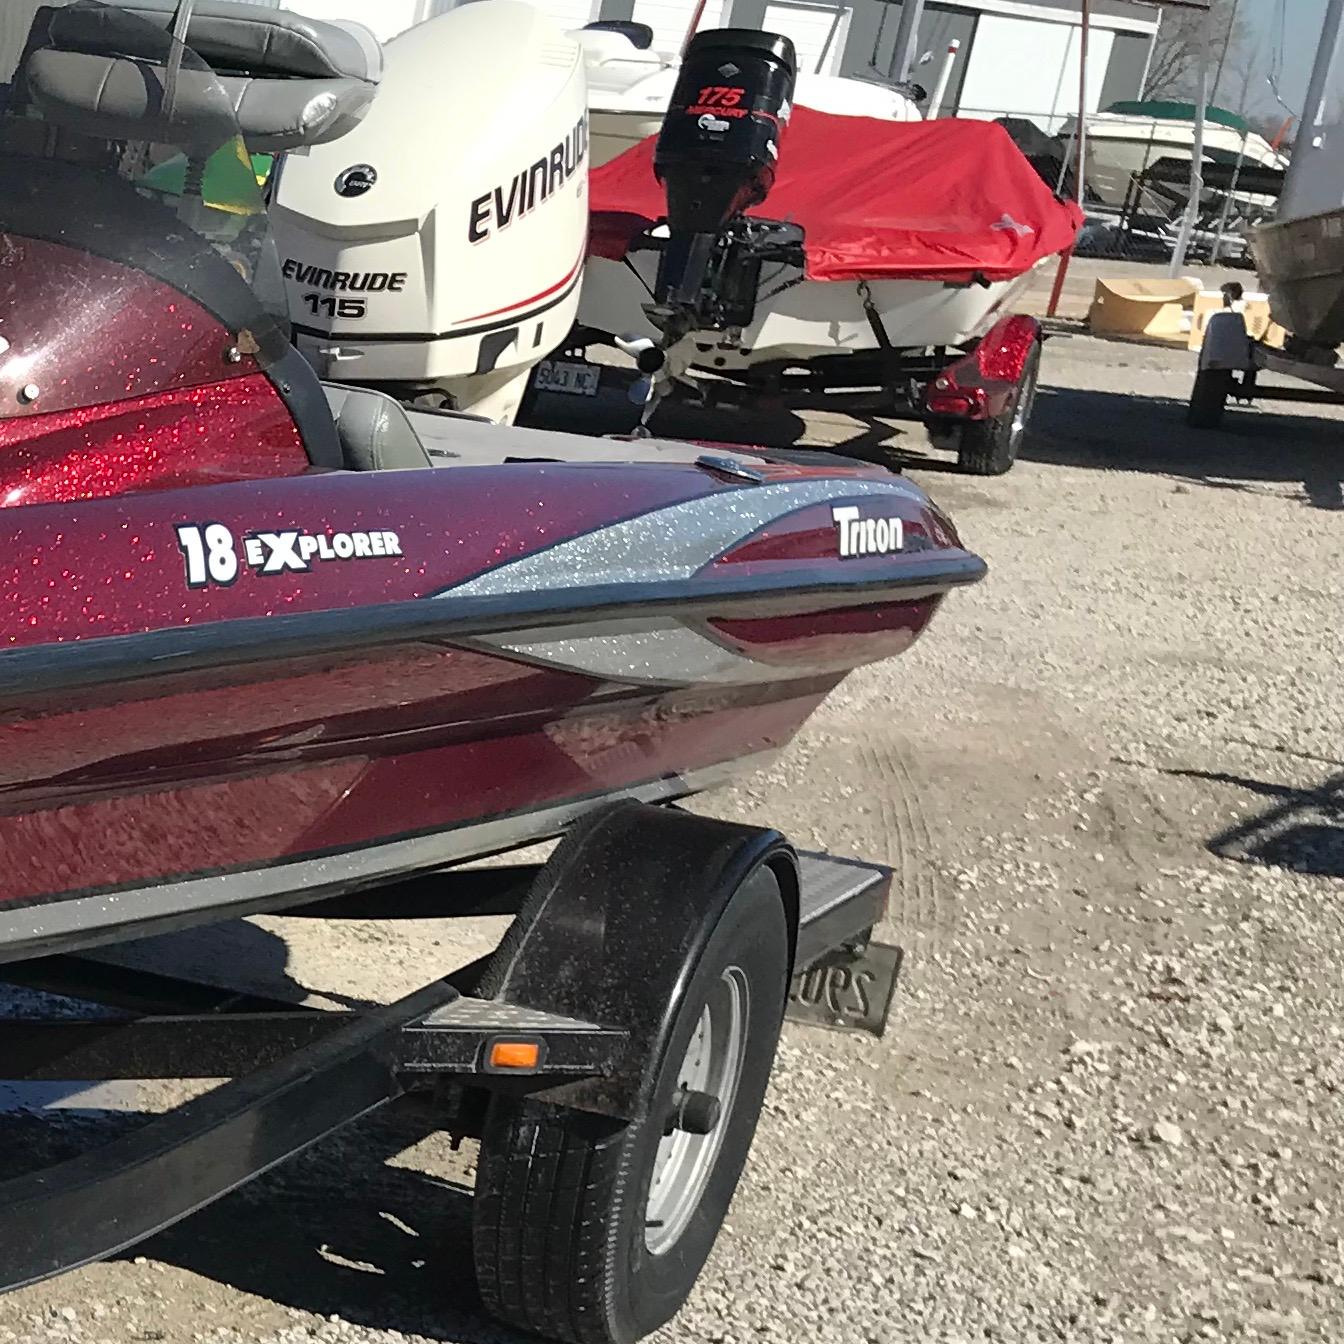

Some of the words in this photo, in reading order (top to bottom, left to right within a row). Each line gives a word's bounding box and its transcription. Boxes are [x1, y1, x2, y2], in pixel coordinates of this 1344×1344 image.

[697, 86, 746, 106] 175
[468, 114, 587, 244] EVINRUD
[282, 258, 408, 293] EVINRUDE
[303, 293, 367, 320] 115
[832, 505, 904, 556] Triton
[177, 523, 238, 584] 18
[244, 531, 403, 572] EXPLORER
